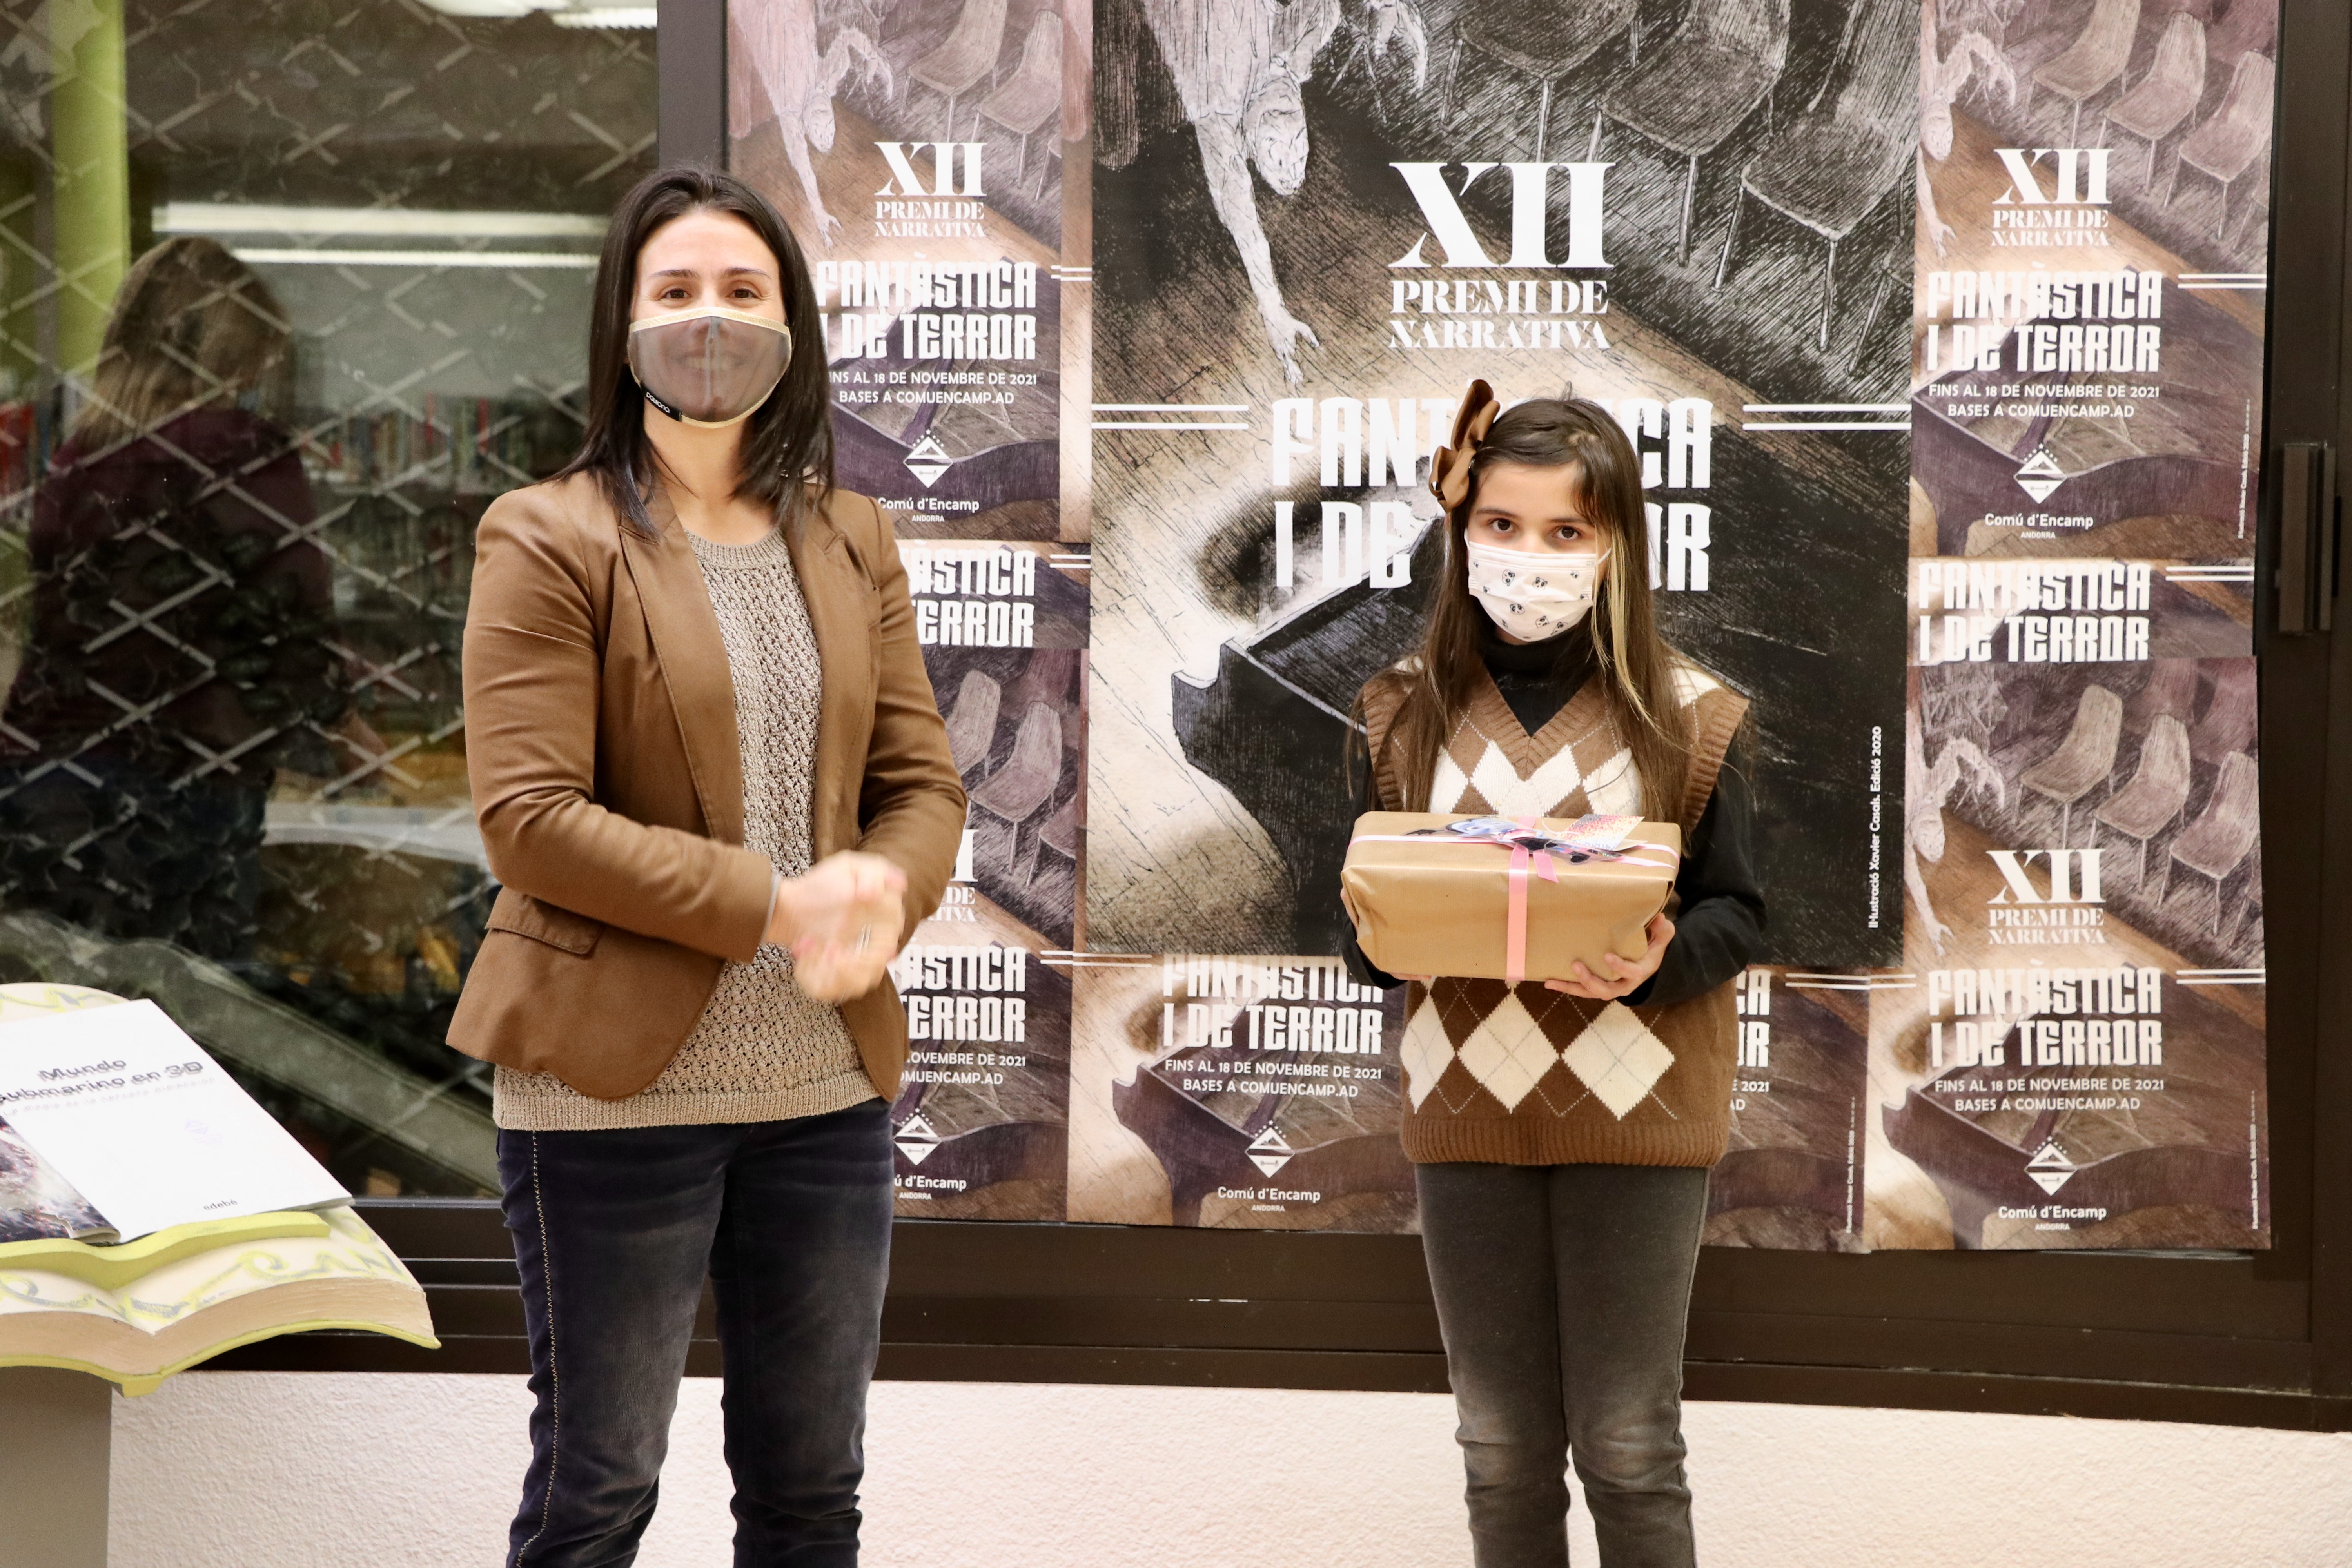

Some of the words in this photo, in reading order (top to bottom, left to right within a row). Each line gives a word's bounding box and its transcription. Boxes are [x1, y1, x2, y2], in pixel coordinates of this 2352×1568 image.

[874, 142, 987, 196] XII
[1992, 149, 2114, 204] XII
[876, 202, 949, 219] PREMI
[955, 202, 984, 220] DE
[1388, 162, 1616, 268] XII
[1993, 210, 2071, 228] PREMI
[2077, 210, 2108, 227] DE
[875, 222, 985, 237] NARRATIVA
[1991, 231, 2109, 246] NARRATIVA
[1390, 280, 1539, 314] PREMI
[1549, 280, 1609, 314] DE
[841, 314, 887, 359] DE
[900, 314, 1037, 360] TERROR
[1389, 320, 1611, 348] NARRATIVA
[1927, 325, 1939, 371] I
[1952, 325, 2000, 372] DE
[2013, 325, 2161, 372] TERROR
[829, 372, 849, 384] INS
[853, 372, 870, 384] AL
[874, 373, 885, 384] 18
[890, 372, 906, 384] DE
[911, 372, 984, 385] NOVEMBRE
[989, 372, 1005, 385] DE
[1010, 374, 1037, 385] 2021
[840, 391, 878, 403] BASES
[883, 391, 892, 403] A
[897, 391, 1014, 405] COMUENCAMP.AD
[1929, 384, 1958, 397] FINS
[1963, 384, 1981, 397] AL
[1986, 386, 1996, 397] 18
[2002, 385, 2020, 397] DE
[2024, 385, 2102, 397] NOVEMBRE
[2107, 385, 2125, 397] DE
[2131, 386, 2160, 397] 2021
[1948, 404, 1989, 417] BASES
[1994, 404, 2004, 417] A
[2008, 405, 2134, 417] COMUENCAMP.AD
[878, 497, 914, 510] Comú
[917, 498, 980, 513] d'Encamp
[1985, 513, 2024, 526] Comú
[2027, 514, 2094, 530] d'Encamp
[1275, 501, 1294, 587] I
[1320, 501, 1412, 588] DE
[911, 600, 1035, 647] ERROR
[1919, 615, 1931, 661] I
[1944, 615, 1992, 662] DE
[2004, 616, 2150, 663] TERROR
[1872, 726, 1881, 756] 2020
[1870, 757, 1881, 792] Edició
[1869, 794, 1880, 832] Casals.
[1869, 833, 1880, 870] Xavier
[1985, 849, 2107, 904] XII
[946, 887, 975, 904] DE
[1989, 909, 2067, 927] PREMI
[2073, 908, 2104, 926] DE
[1989, 929, 2106, 944] NARRATIVA
[899, 995, 1026, 1042] ERROR
[1163, 1003, 1174, 1047] I
[1187, 1003, 1233, 1048] DE
[1245, 1005, 1383, 1054] TERROR
[1931, 1022, 1942, 1067] I
[1956, 1022, 2005, 1067] DE
[2016, 1020, 2163, 1066] TERROR
[907, 1052, 973, 1065] OVEMBRE
[978, 1054, 995, 1065] DE
[999, 1055, 1026, 1066] 2021
[38, 1060, 127, 1081] Mundo
[131, 1071, 161, 1085] en
[165, 1062, 203, 1076] 3D
[900, 1071, 1004, 1085] MUENCAMP.AD
[1165, 1059, 1194, 1072] FINS
[1198, 1060, 1215, 1073] AL
[1219, 1062, 1230, 1073] 18
[1234, 1061, 1252, 1074] DE
[1256, 1062, 1328, 1077] NOVEMBRE
[1333, 1065, 1350, 1078] DE
[1354, 1067, 1382, 1080] 2021
[1183, 1078, 1222, 1093] BASES
[1227, 1080, 1236, 1093] A
[1240, 1081, 1358, 1098] COMUENCAMP.AD
[1741, 1081, 1769, 1093] 2021
[1935, 1079, 1965, 1092] FINS
[1969, 1080, 1987, 1092] AL
[1991, 1080, 2003, 1091] 18
[2007, 1079, 2025, 1091] DE
[2030, 1078, 2107, 1091] NOVEMBRE
[2112, 1078, 2131, 1090] DE
[2135, 1079, 2164, 1090] 2021
[1955, 1098, 1996, 1111] BASES
[2001, 1099, 2011, 1111] A
[2015, 1098, 2140, 1111] COMUENCAMP.AD
[1217, 1186, 1254, 1200] Comú
[1258, 1188, 1321, 1203] d'Encamp
[203, 1199, 238, 1211] edebé
[1998, 1205, 2037, 1219] Comú
[2040, 1205, 2107, 1221] d'Encamp
